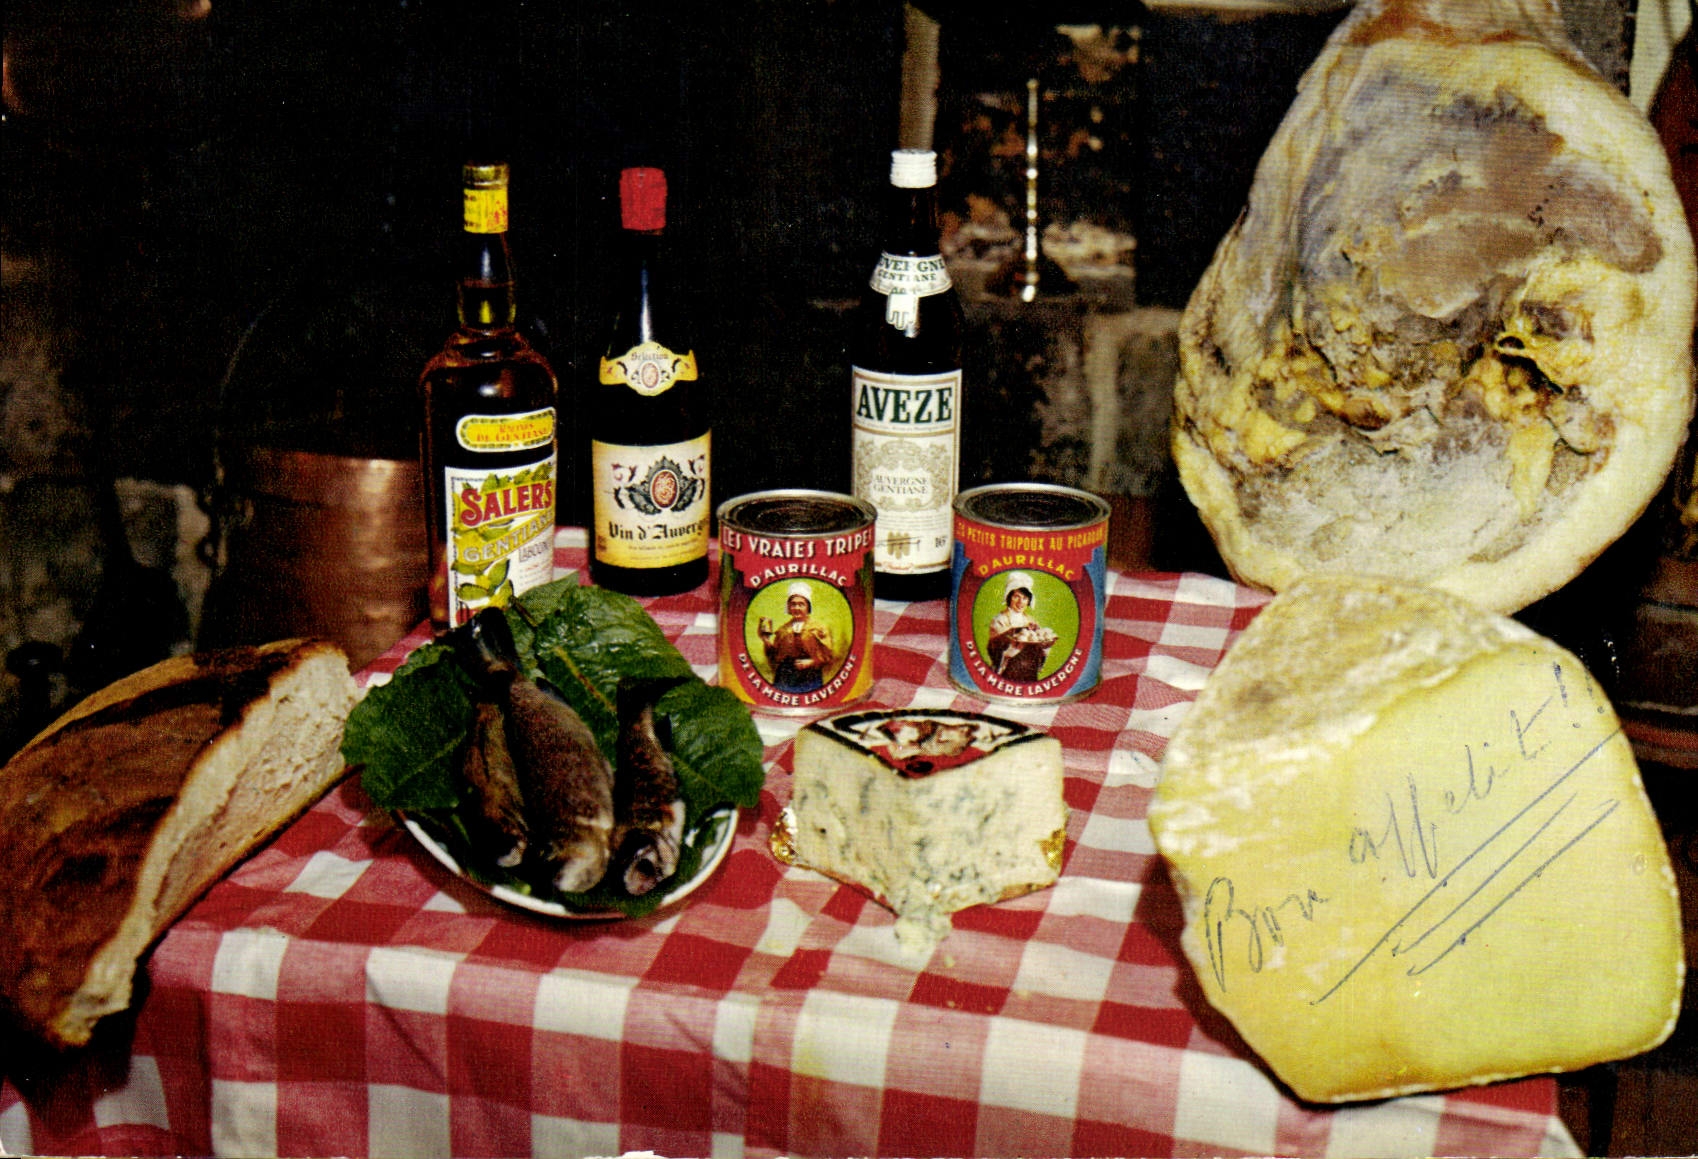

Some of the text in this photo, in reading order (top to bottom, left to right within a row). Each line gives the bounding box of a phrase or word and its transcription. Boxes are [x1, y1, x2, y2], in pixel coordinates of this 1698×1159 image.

[857, 384, 953, 424] AVEZE
[460, 479, 552, 527] SALERS
[609, 521, 633, 541] Vin
[722, 526, 742, 550] LES
[748, 536, 815, 558] VRAIES
[967, 527, 996, 547] PETITS
[1001, 535, 1044, 551] TRIPOUX
[1050, 537, 1063, 550] AU
[750, 563, 848, 588] D'AURILLAC
[738, 653, 751, 670] DE
[748, 672, 762, 688] LA
[804, 653, 857, 705] LAVERGNE
[965, 640, 977, 658] DE
[974, 660, 986, 676] LA
[1027, 648, 1083, 696] LAVERGNE
